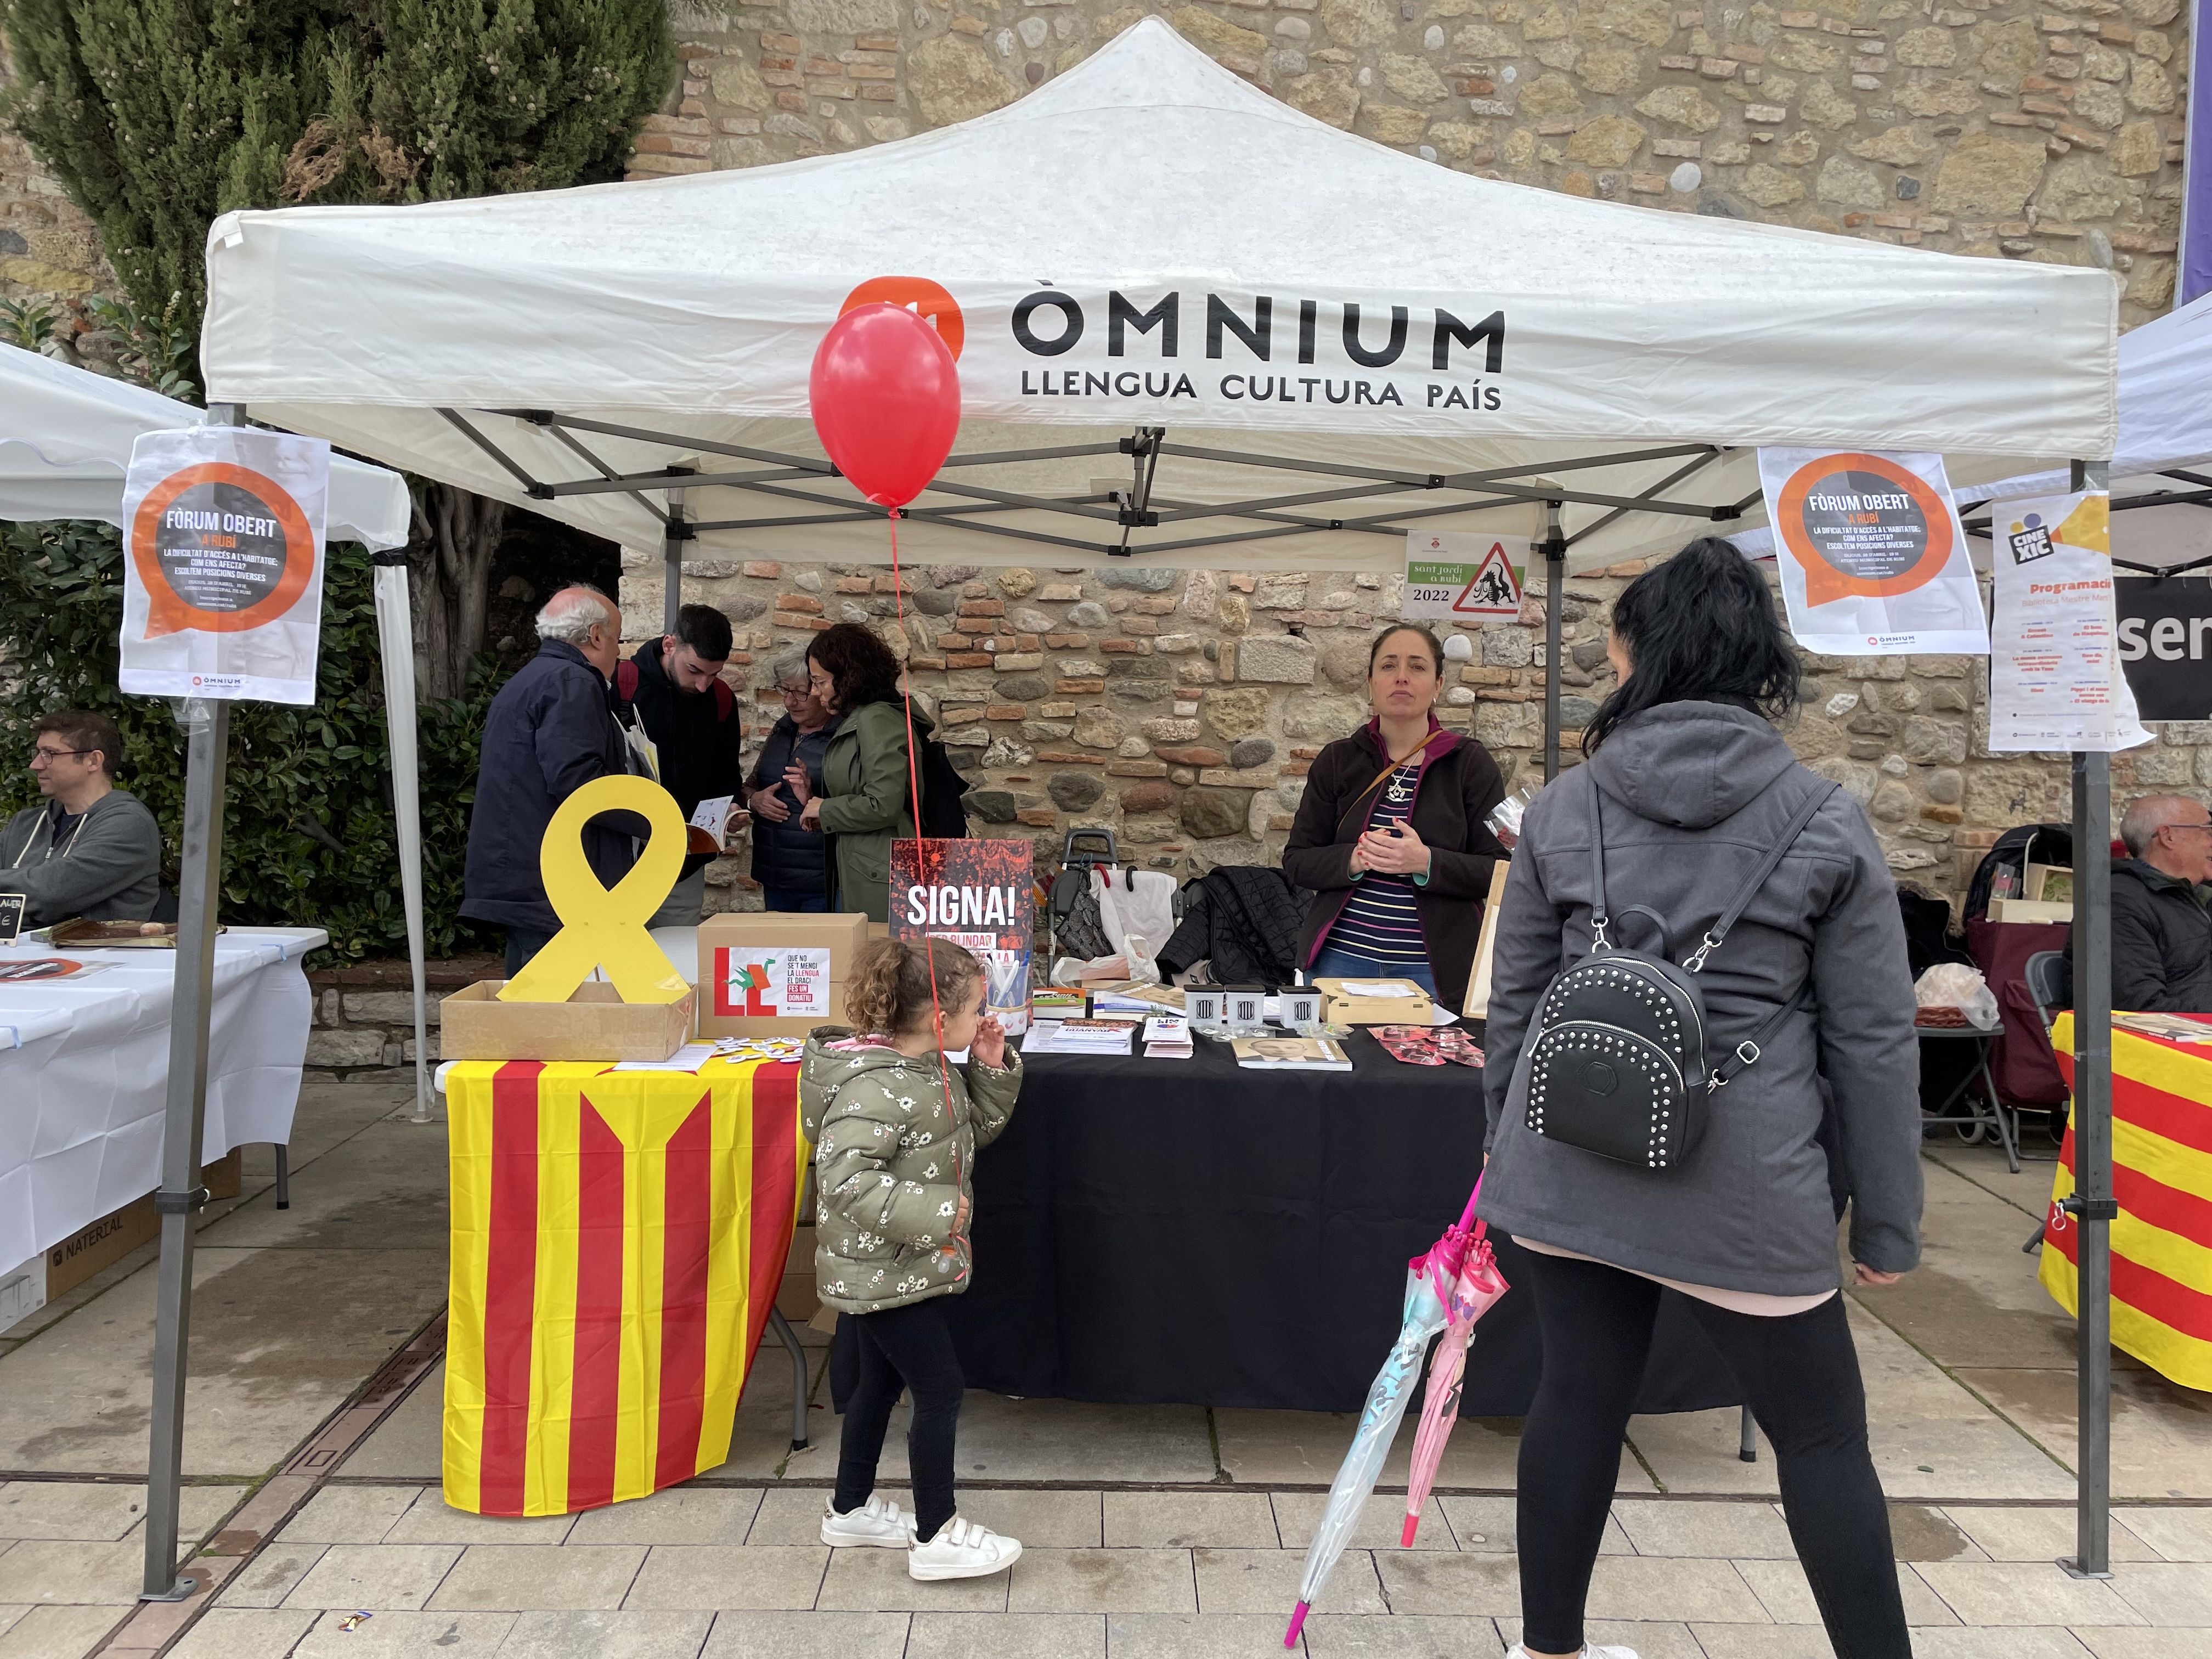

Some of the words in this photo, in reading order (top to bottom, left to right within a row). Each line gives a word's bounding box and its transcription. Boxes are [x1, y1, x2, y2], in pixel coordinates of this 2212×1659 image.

[1011, 279, 1505, 373] ÒMNIUM
[1022, 370, 1198, 399] LLENGUA
[1220, 374, 1403, 406] CULTURA
[1426, 378, 1502, 410] PAÍS
[1809, 493, 1861, 511] FÒRUM
[1862, 494, 1909, 511] OBERT
[166, 507, 219, 531] FÒRUM
[223, 514, 276, 538] OBERT
[1848, 514, 1855, 524] A
[1857, 511, 1880, 524] RUBÍ
[201, 534, 208, 546] A
[211, 534, 236, 548] RUBÍ
[2013, 529, 2046, 547] CINE
[2016, 539, 2050, 562] XIC
[219, 561, 246, 570] AFECTA?
[1414, 565, 1436, 573] sant
[174, 567, 201, 575] ESCOLTEM
[202, 568, 235, 578] POSICIONS
[236, 572, 266, 582] DIVERSES
[1413, 589, 1449, 601] 2022
[2022, 599, 2059, 607] Biblioteca
[907, 885, 1015, 926] SIGNA!
[951, 935, 992, 946] BLINDAR
[66, 1216, 123, 1260] NATERIAL
